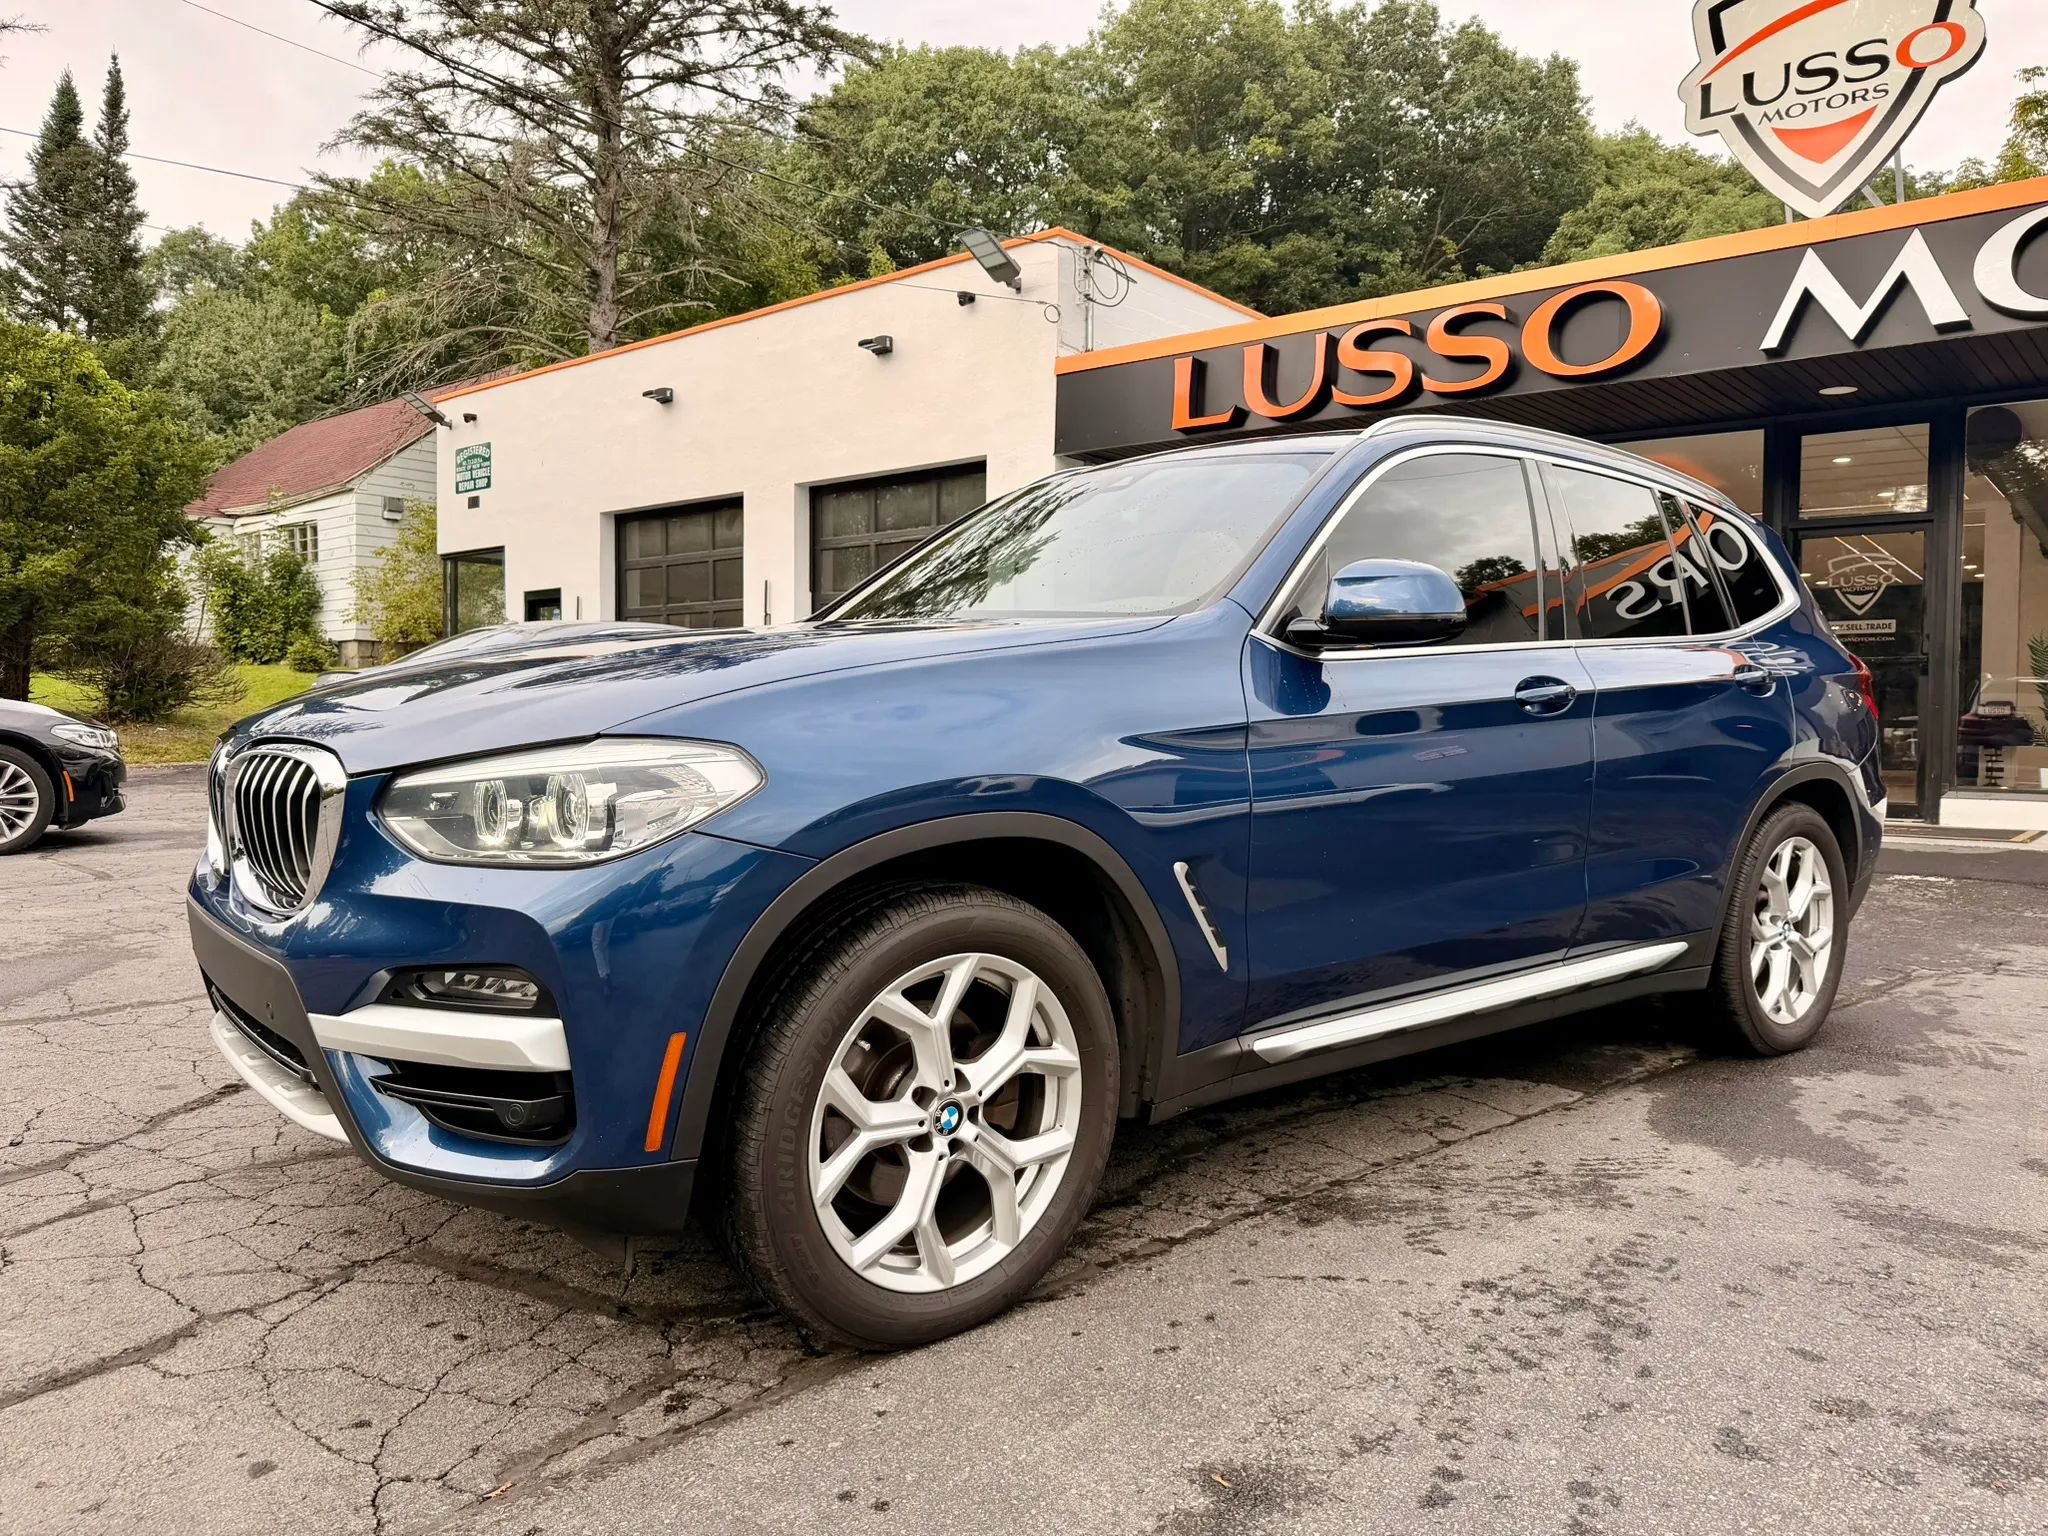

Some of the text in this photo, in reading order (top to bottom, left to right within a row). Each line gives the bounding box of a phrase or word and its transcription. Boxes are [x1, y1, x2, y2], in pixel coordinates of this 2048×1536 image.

[1700, 21, 1966, 120] LUSSO
[1758, 83, 1889, 126] MOTORS
[1172, 280, 1664, 431] LUSSO
[456, 445, 491, 465] REGISTERED
[456, 466, 491, 482] MOTOR VEHICLE
[458, 477, 488, 492] REPAIR SHOP
[1829, 574, 1896, 588] LUSSO
[1841, 585, 1878, 593] MOTORS
[776, 980, 860, 1217] BRIDGESTONE
